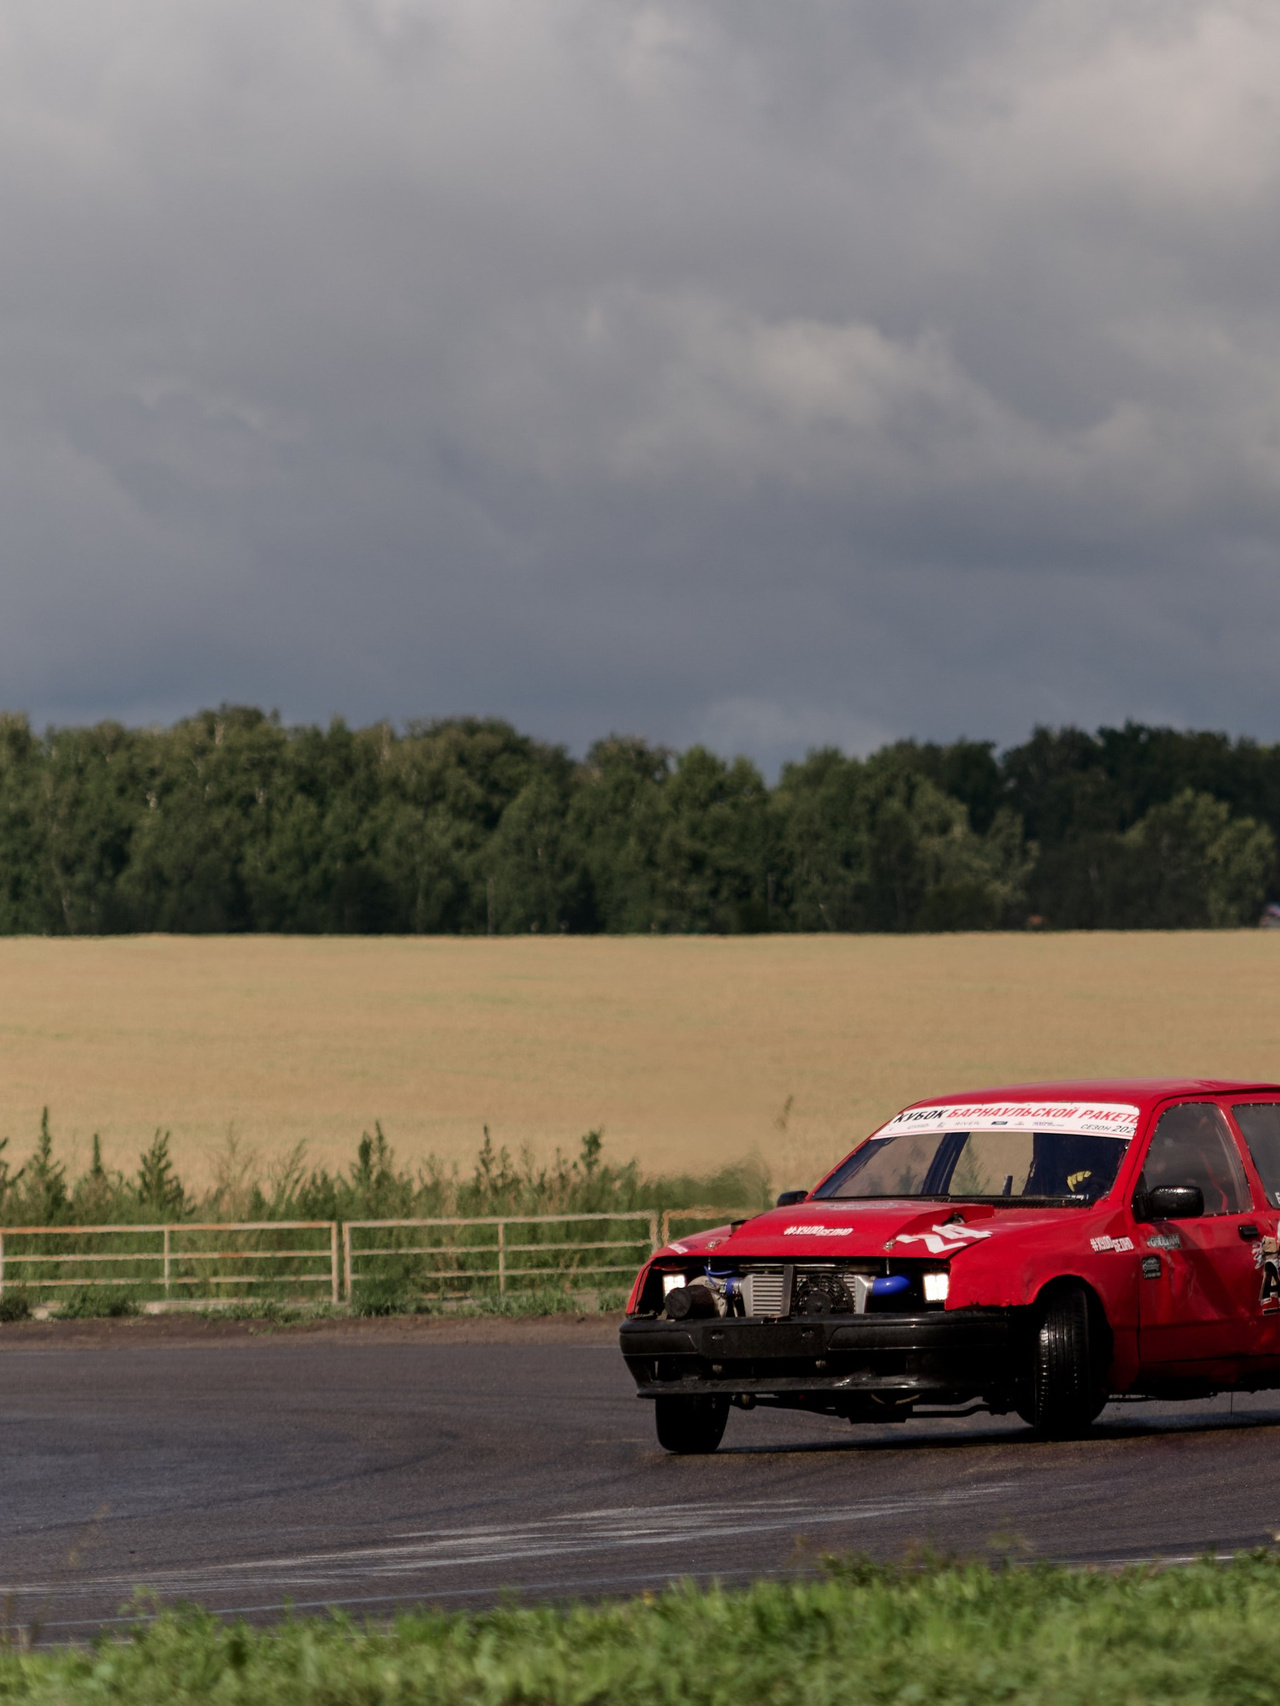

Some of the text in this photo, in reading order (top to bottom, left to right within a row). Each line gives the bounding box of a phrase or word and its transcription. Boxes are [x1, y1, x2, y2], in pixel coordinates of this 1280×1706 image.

[893, 1109, 949, 1123] КУБОК
[946, 1105, 1079, 1118] БАРНАУЛЬСКОЙ
[1080, 1124, 1111, 1132] СЕЗОН
